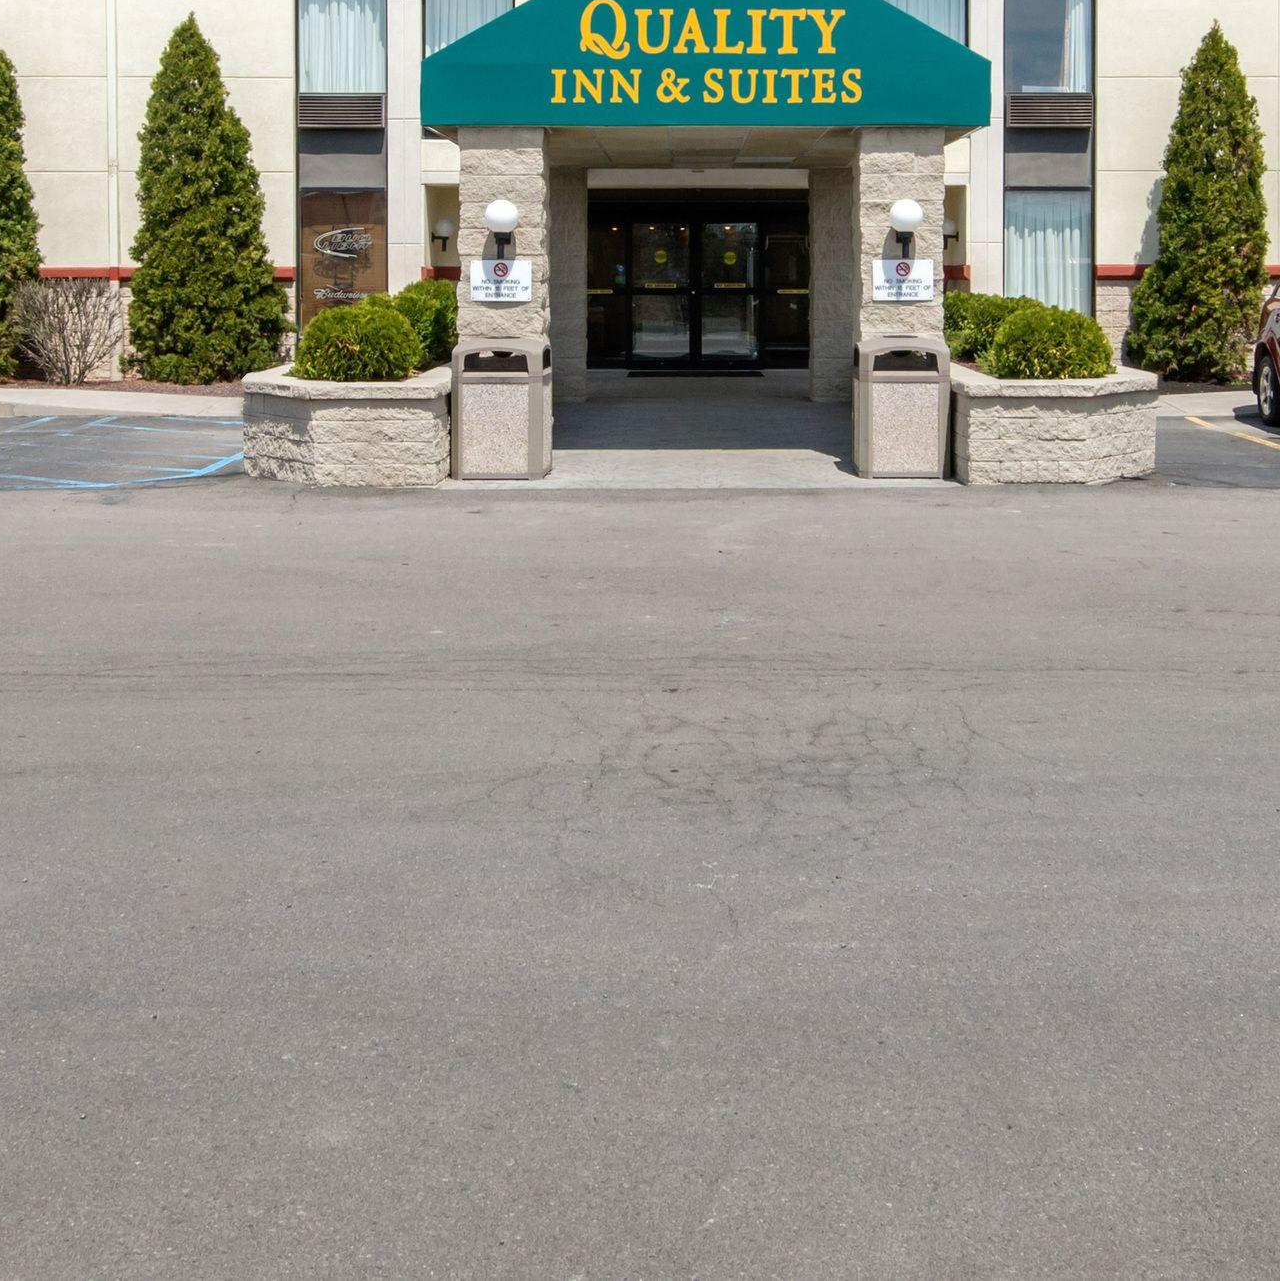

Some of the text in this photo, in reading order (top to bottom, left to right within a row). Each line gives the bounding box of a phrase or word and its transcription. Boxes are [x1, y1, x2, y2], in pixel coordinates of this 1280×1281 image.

[551, 68, 863, 104] INN & SUITES
